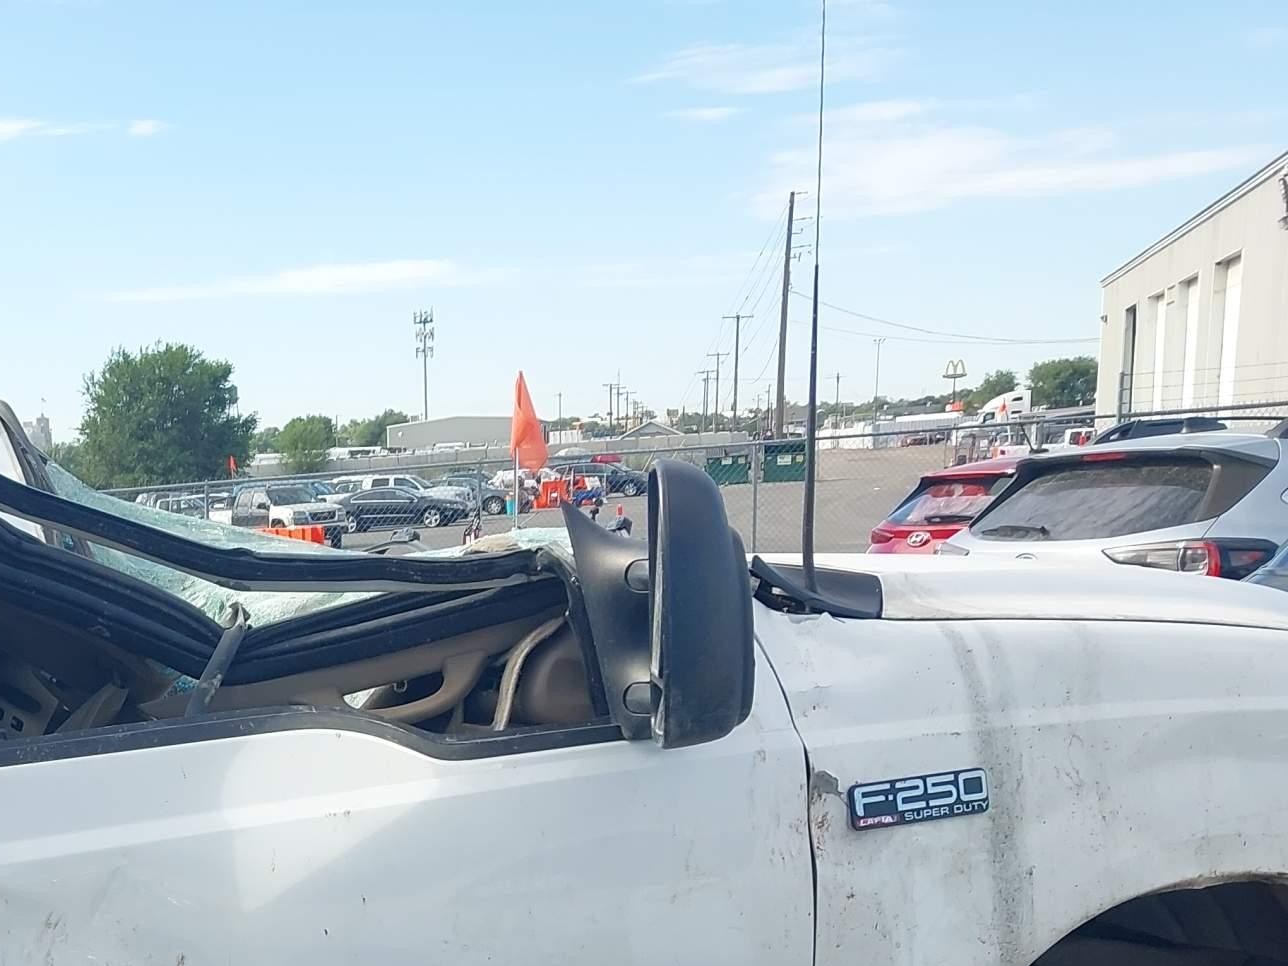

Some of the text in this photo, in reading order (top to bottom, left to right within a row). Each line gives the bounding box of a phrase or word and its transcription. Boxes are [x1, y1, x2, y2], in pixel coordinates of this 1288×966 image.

[854, 769, 988, 817] F-250
[904, 800, 989, 821] SUPER DUTY
